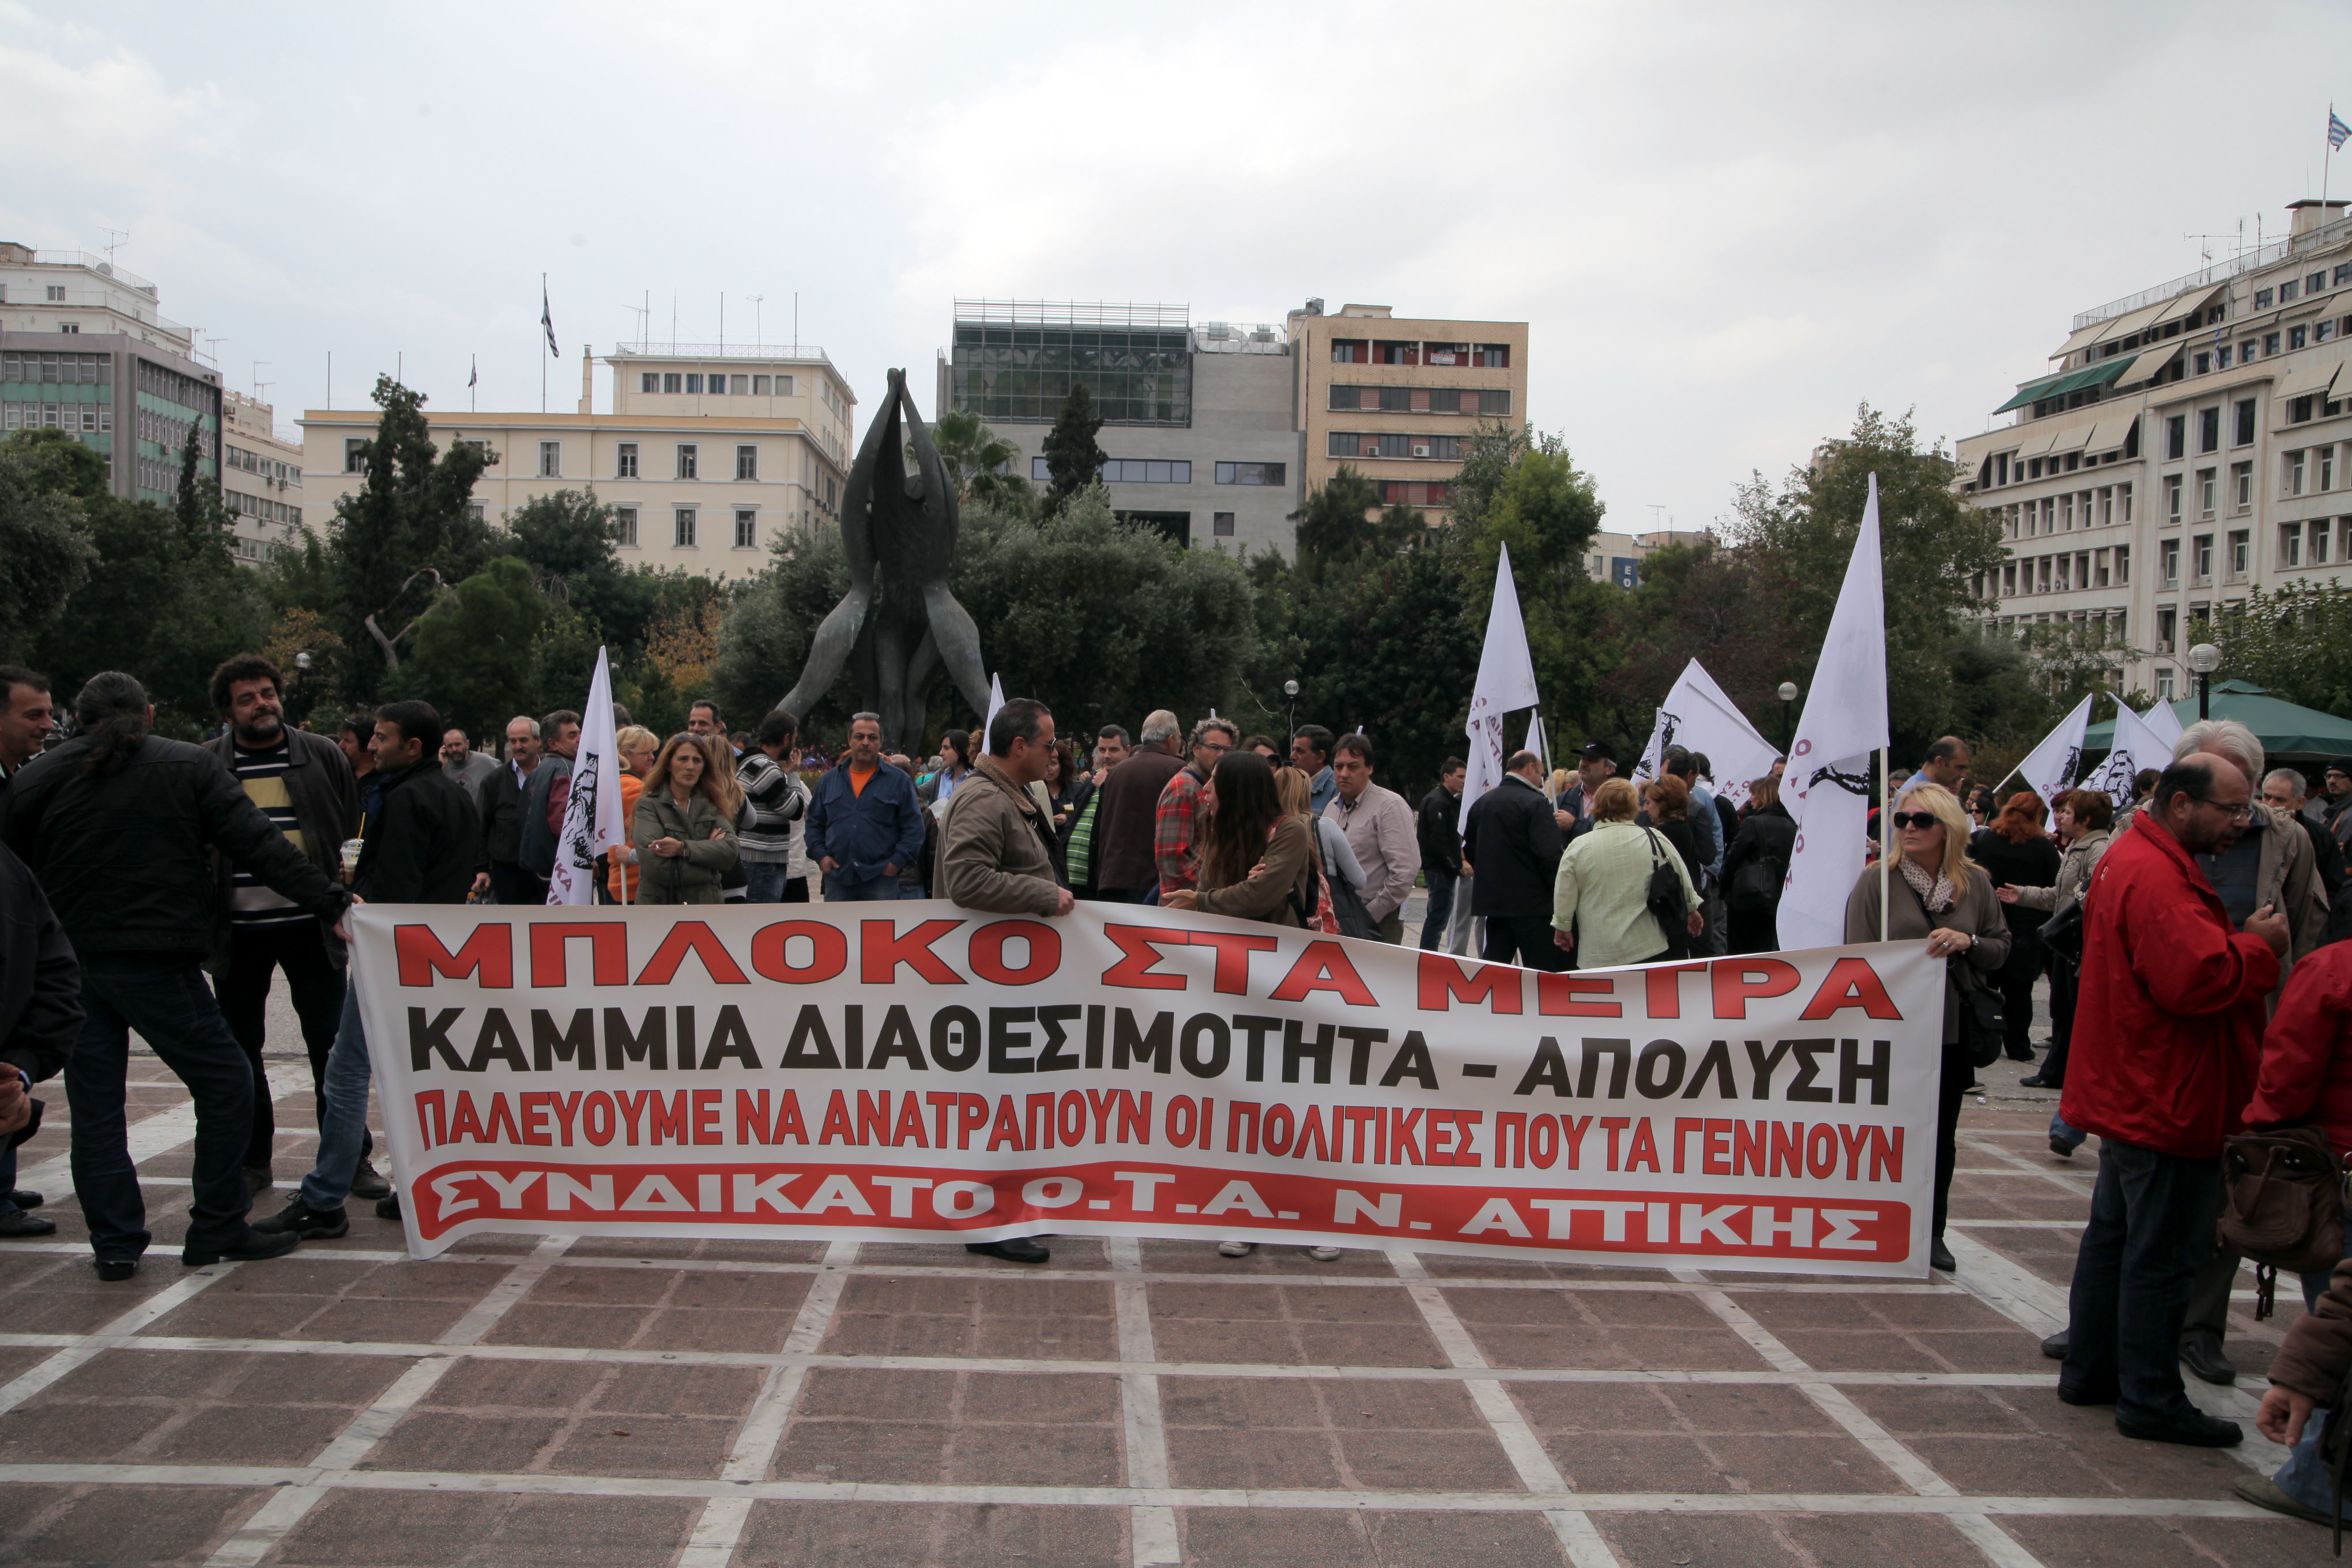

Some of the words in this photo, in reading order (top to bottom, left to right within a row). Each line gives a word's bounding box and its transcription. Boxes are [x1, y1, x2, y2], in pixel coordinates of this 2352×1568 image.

[394, 919, 1062, 989] ΜΠΛΟΚΟ
[1101, 922, 1380, 1007] ΣΤΑ
[1416, 952, 1904, 1020] ΜΕΤΡΑ
[407, 1005, 763, 1072] ΚΑΜΜΙΑ
[779, 1004, 1439, 1090] ΔΙΑΘΕΣΙΜΟΤΗΤΑ
[1513, 1036, 1891, 1106] ΑΠΟΛΥΣΗ
[414, 1090, 723, 1152] ΠΑΛΕΥΟΥΜΕ
[736, 1089, 809, 1145] ΝΑ
[818, 1089, 1153, 1152] ΑΝΑΤΡΑΠΟΥΝ
[1165, 1094, 1214, 1151] ΟΙ
[1226, 1100, 1483, 1167] ΠΟΛΙΤΙΚΕΣ
[1494, 1111, 1594, 1171] ΠΟΥ
[1600, 1115, 1661, 1173] ΤΑ
[1673, 1117, 1905, 1183] ΓΕΝΝΟΥΝ
[431, 1170, 994, 1222] ΣΥΝΔΙΚΑΤΟ
[1022, 1171, 1300, 1220] Ο.Τ.Α.
[1333, 1188, 1432, 1230] Ν.
[1457, 1197, 1878, 1251] ΑΤΤΙΚΗΣ
